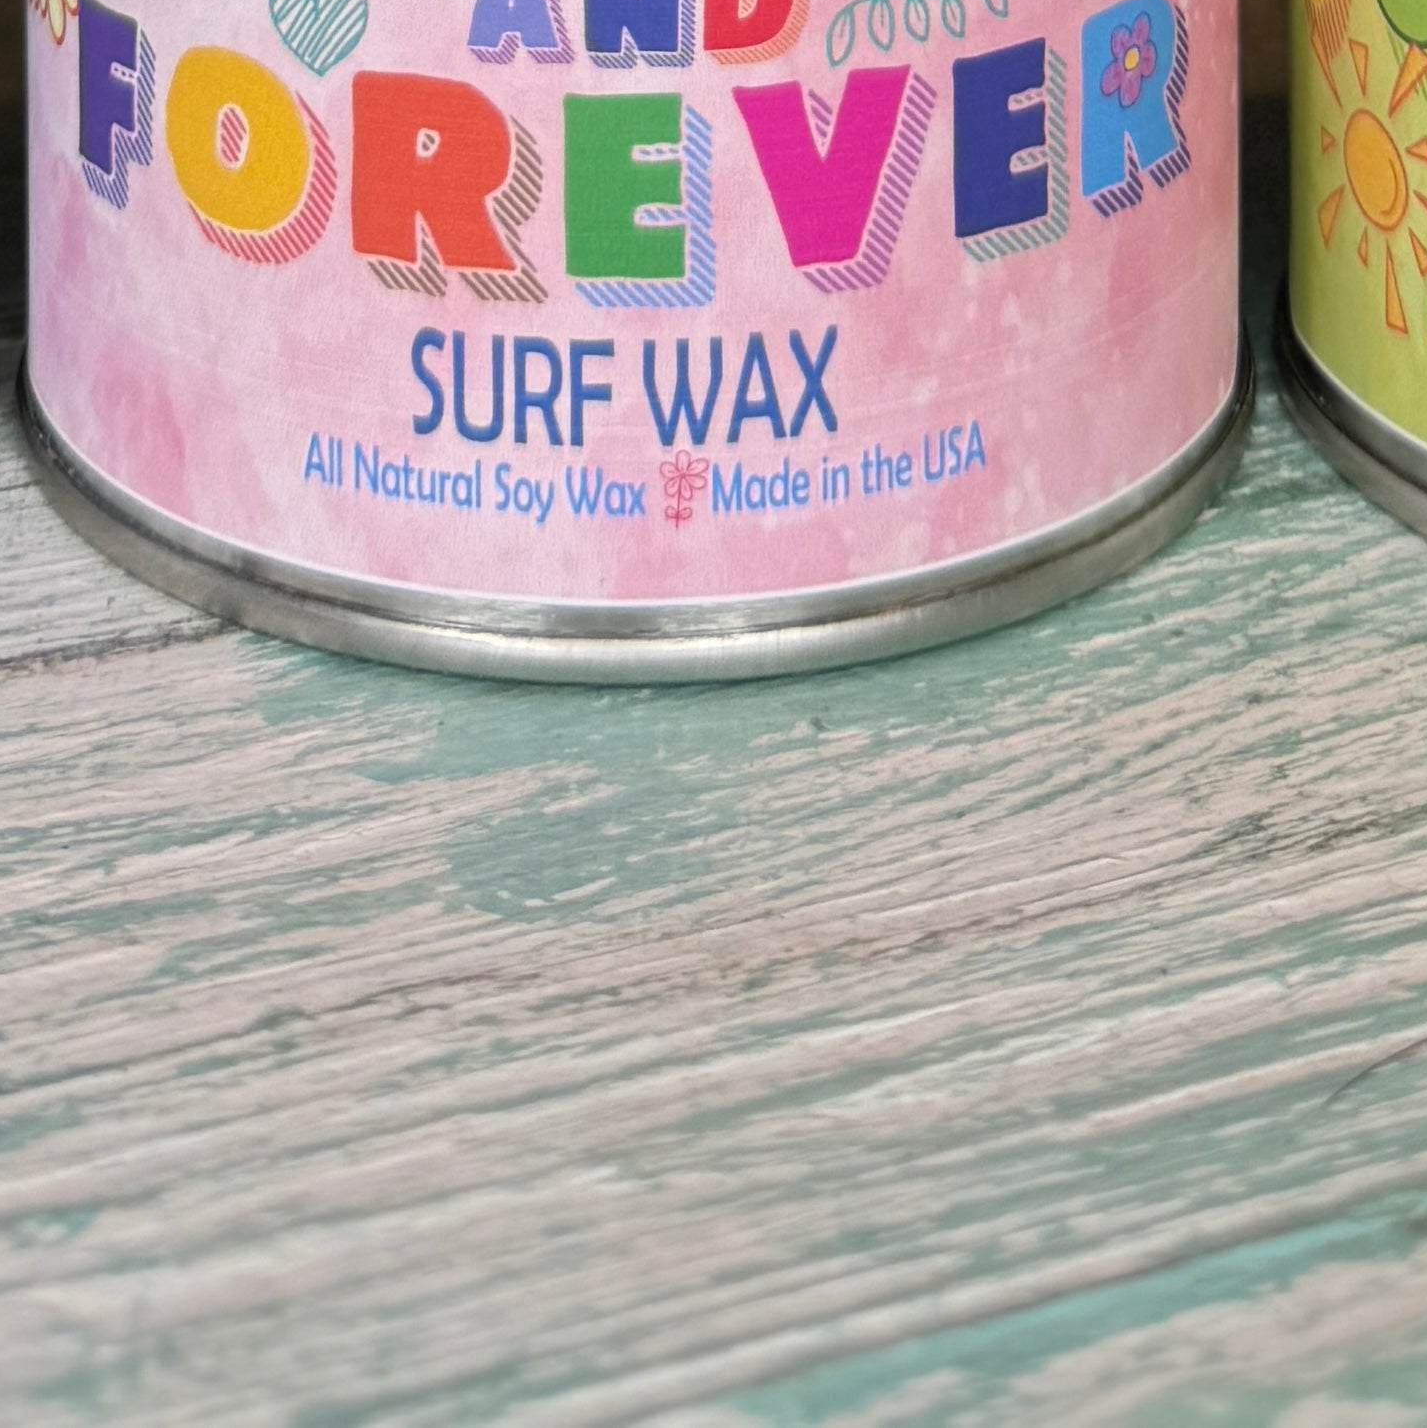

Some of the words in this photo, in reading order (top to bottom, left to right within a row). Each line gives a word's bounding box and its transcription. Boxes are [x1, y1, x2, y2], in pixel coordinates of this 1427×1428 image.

[409, 325, 616, 448] SURF
[641, 323, 839, 446] WAX
[303, 430, 344, 486] All
[352, 441, 482, 508] Natural
[494, 461, 555, 524] Soy
[563, 464, 646, 516] Wax
[710, 454, 810, 514] Made
[821, 448, 852, 487] in
[860, 437, 913, 482] the
[922, 419, 987, 482] USA
